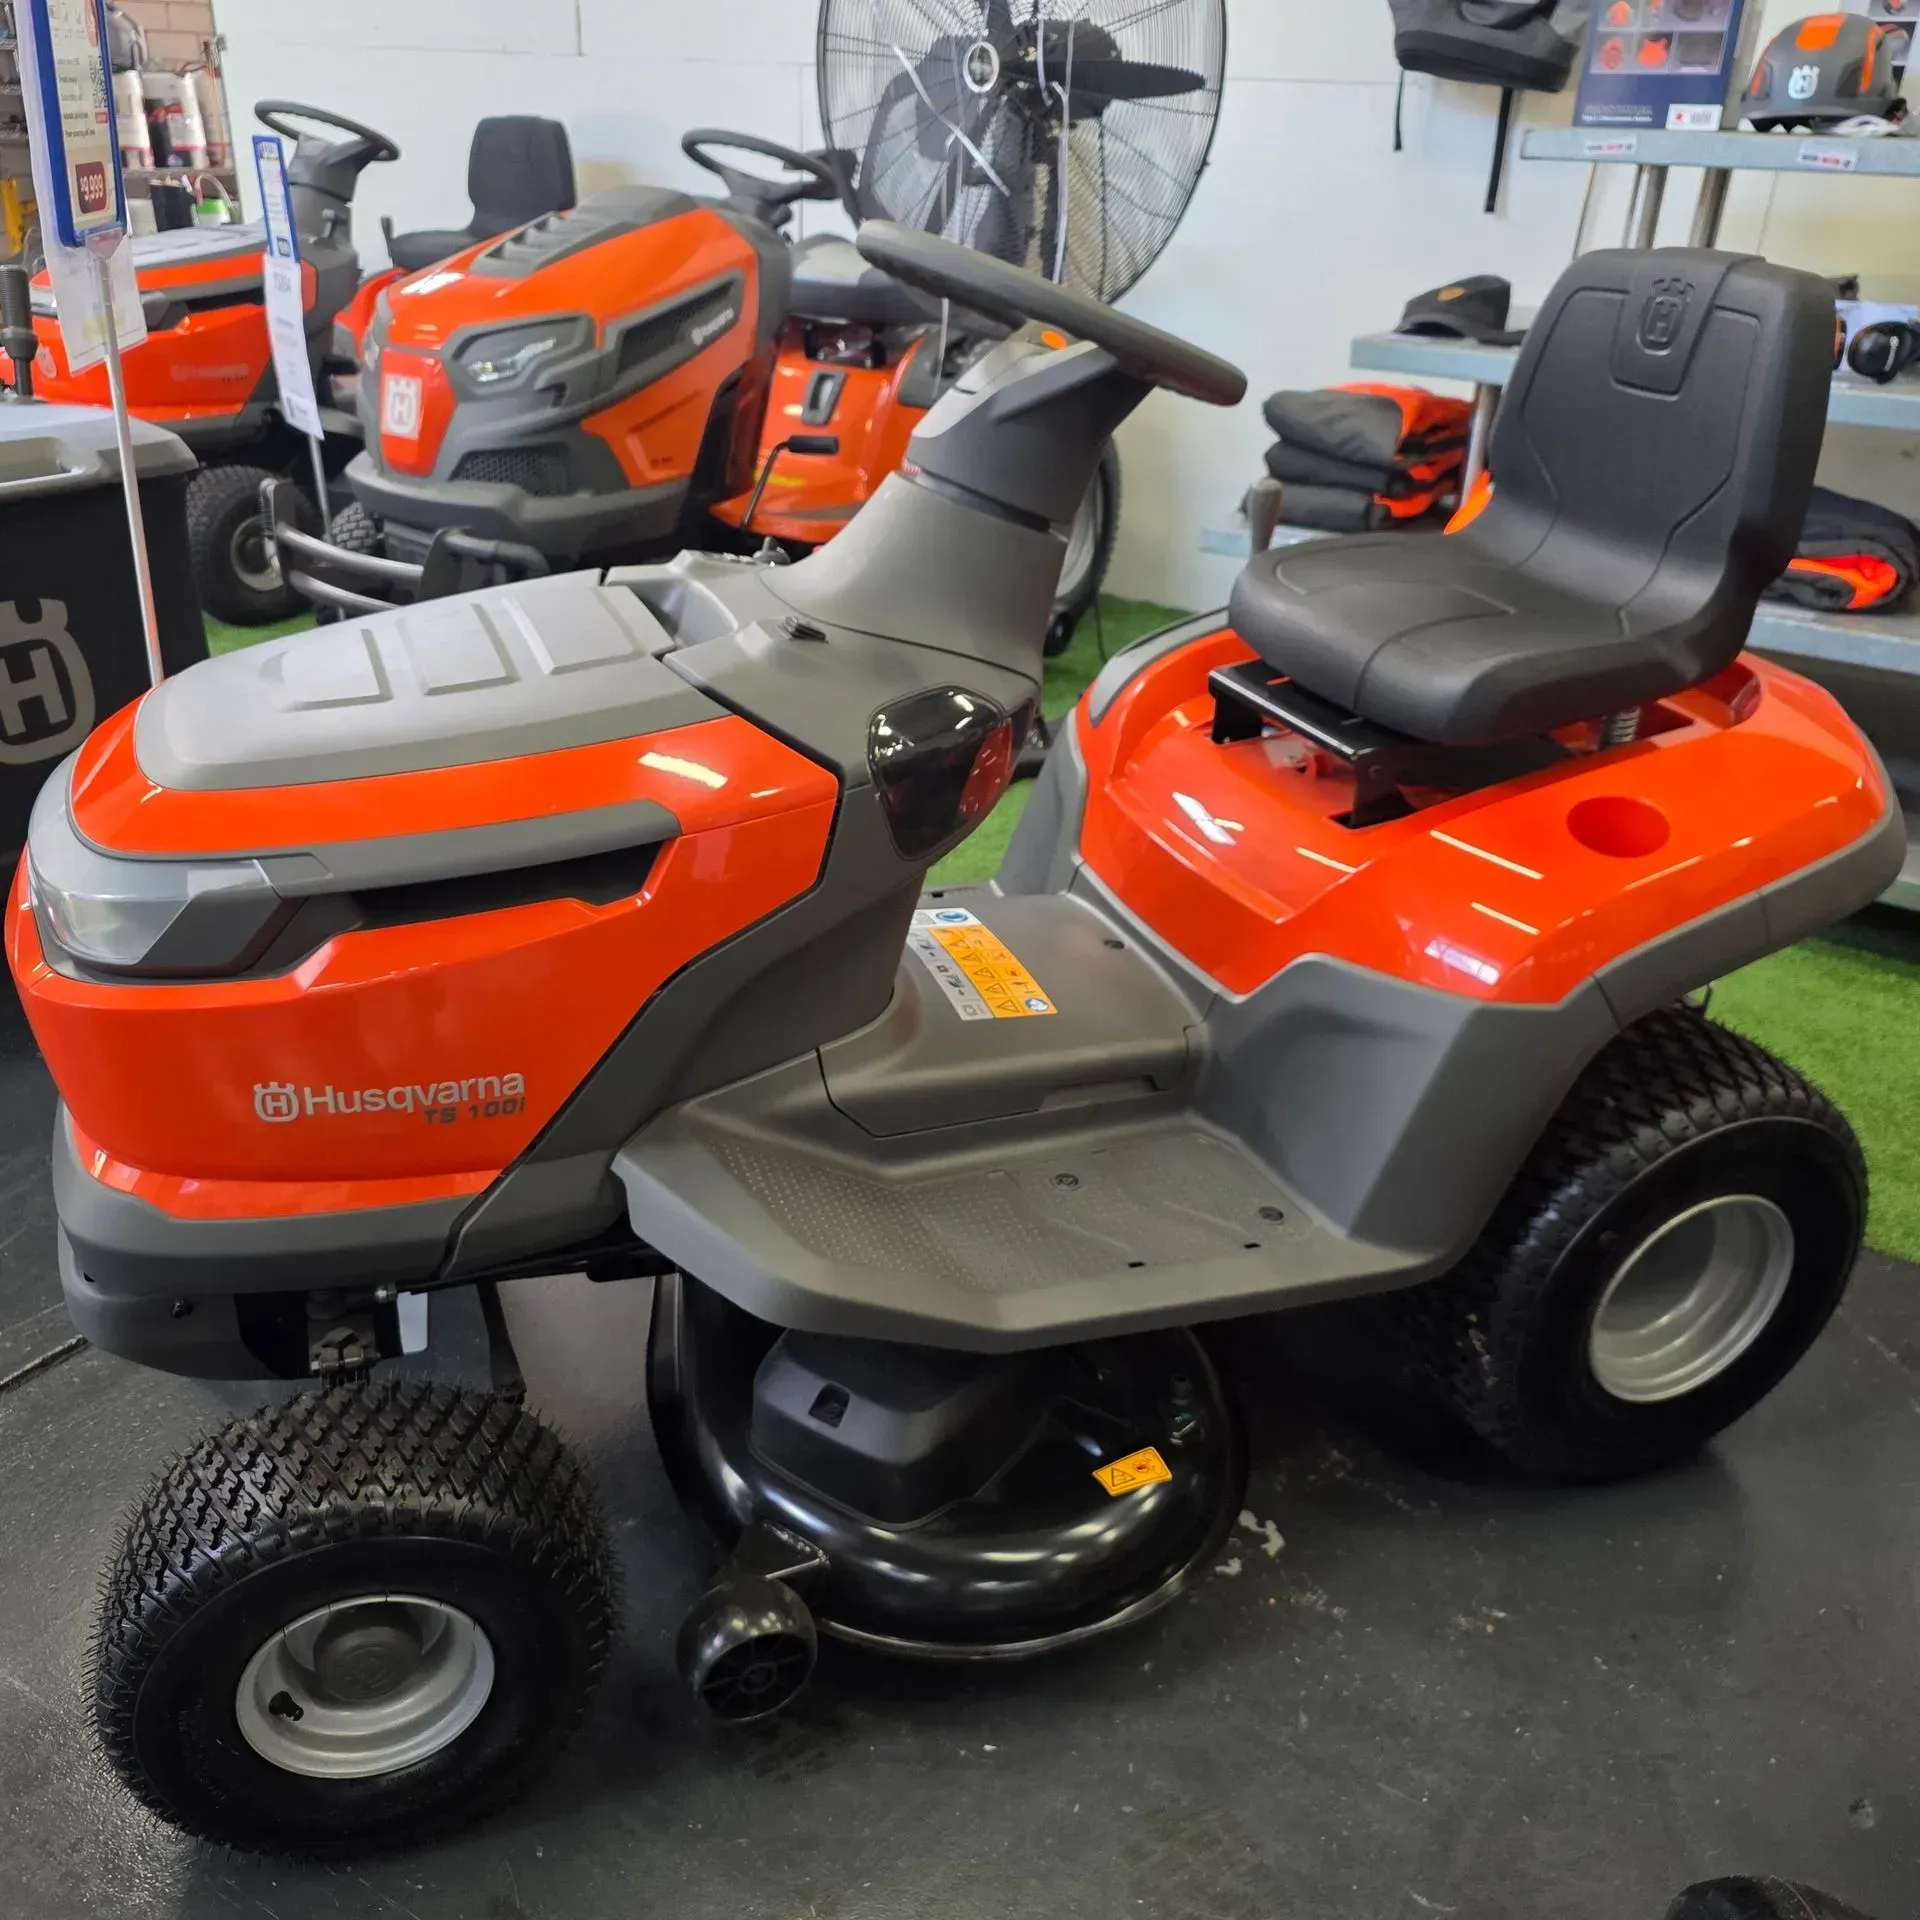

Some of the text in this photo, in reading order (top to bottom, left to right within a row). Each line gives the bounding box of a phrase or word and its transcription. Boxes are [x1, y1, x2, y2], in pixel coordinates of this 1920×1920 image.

[303, 1072, 525, 1116] Husqvarna
[424, 1096, 526, 1125] TS 100i
